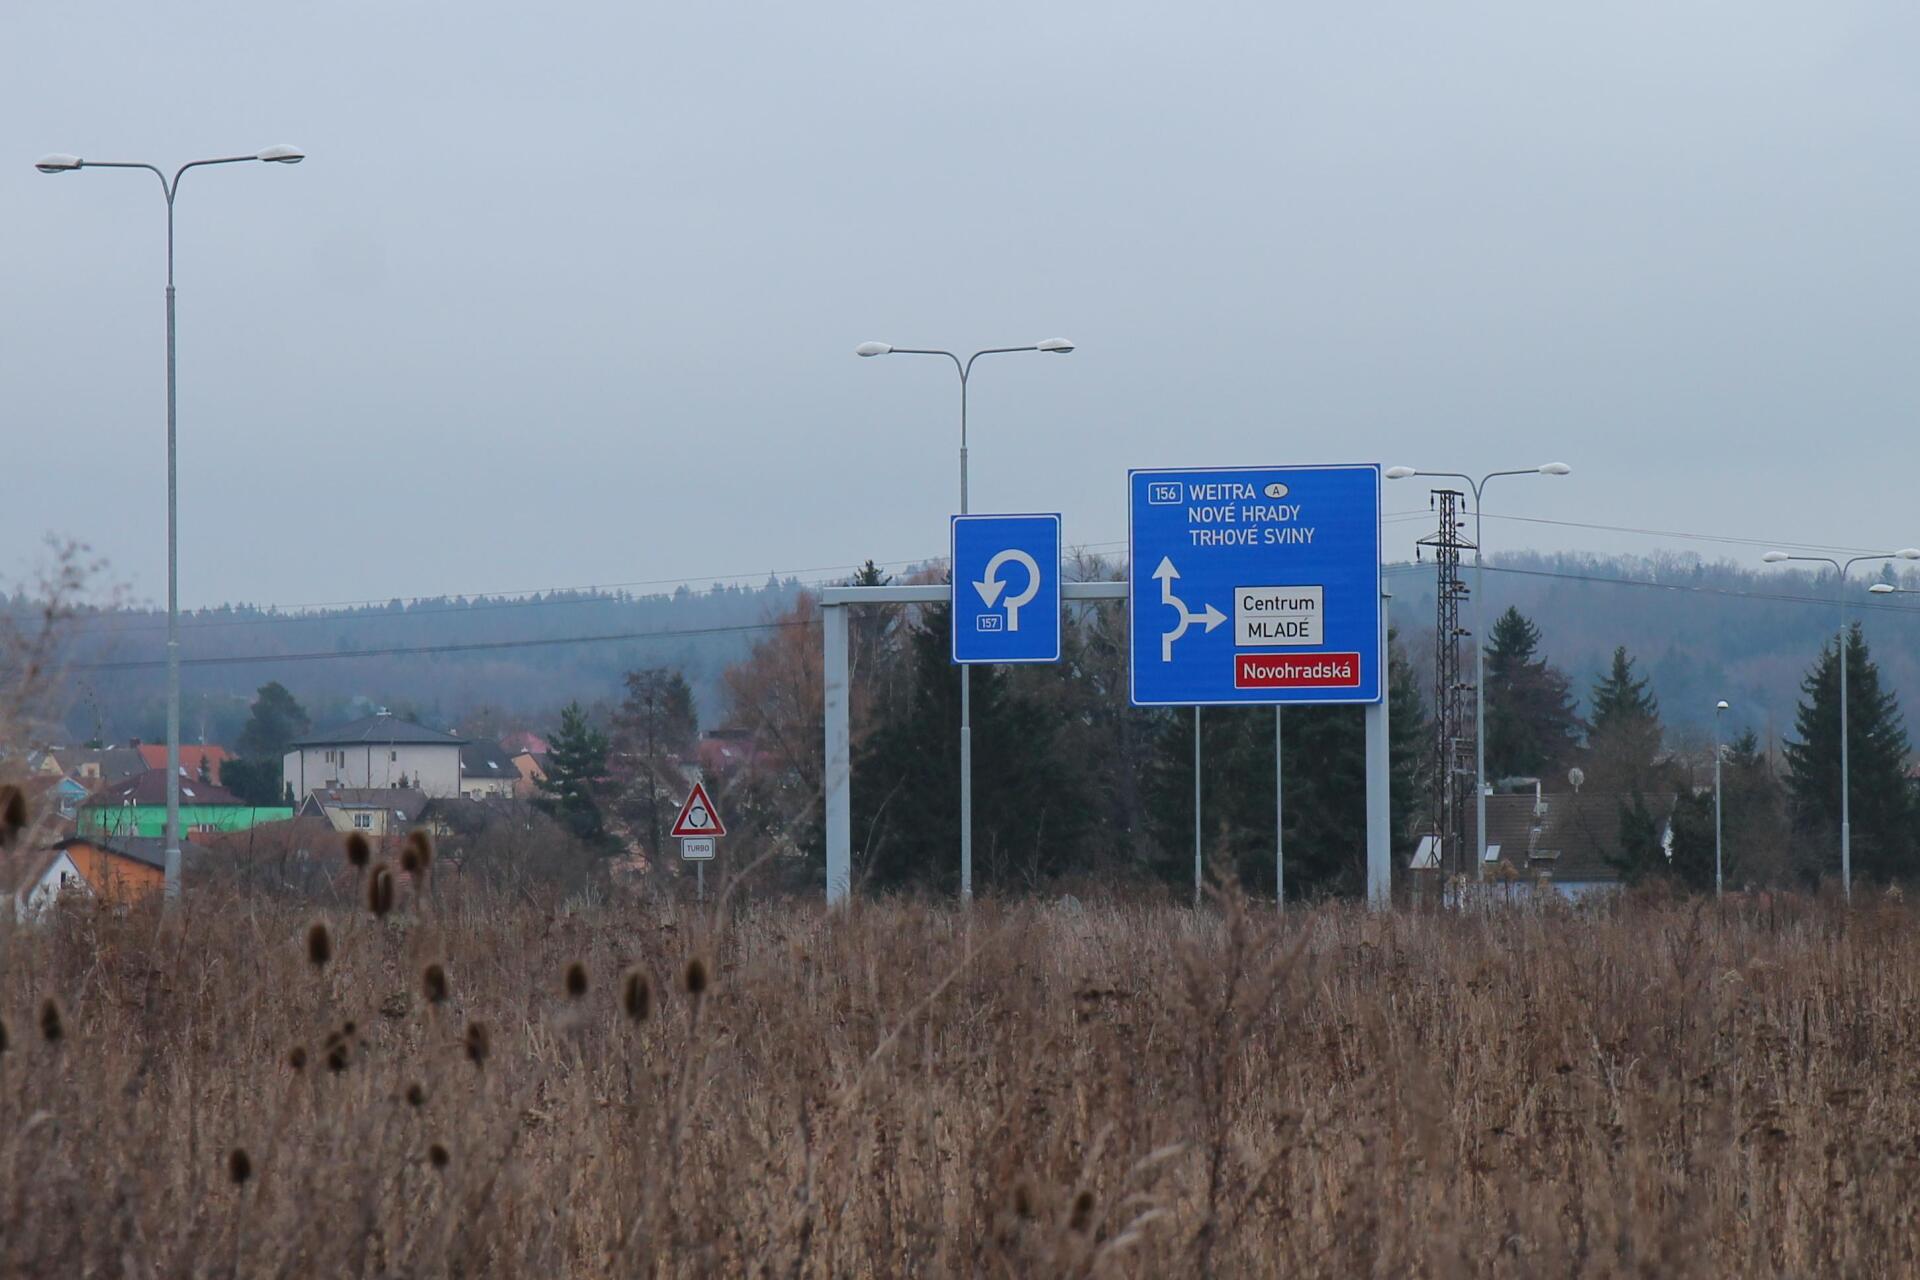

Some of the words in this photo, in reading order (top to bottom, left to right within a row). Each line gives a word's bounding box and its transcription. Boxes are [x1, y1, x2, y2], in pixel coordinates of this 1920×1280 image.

[1155, 487, 1176, 500] 156
[1189, 483, 1256, 501] WEITRA
[1272, 486, 1280, 496] A
[1188, 502, 1235, 523] NOVÉ
[1242, 505, 1300, 522] HRADY
[1189, 524, 1258, 546] TRHOVÉ
[1264, 527, 1315, 544] SVINY
[1243, 595, 1315, 611] Centrum
[982, 618, 997, 628] 157
[1248, 617, 1309, 638] MLADÉ
[1243, 661, 1351, 679] Novohradská
[687, 844, 710, 852] TURBO
